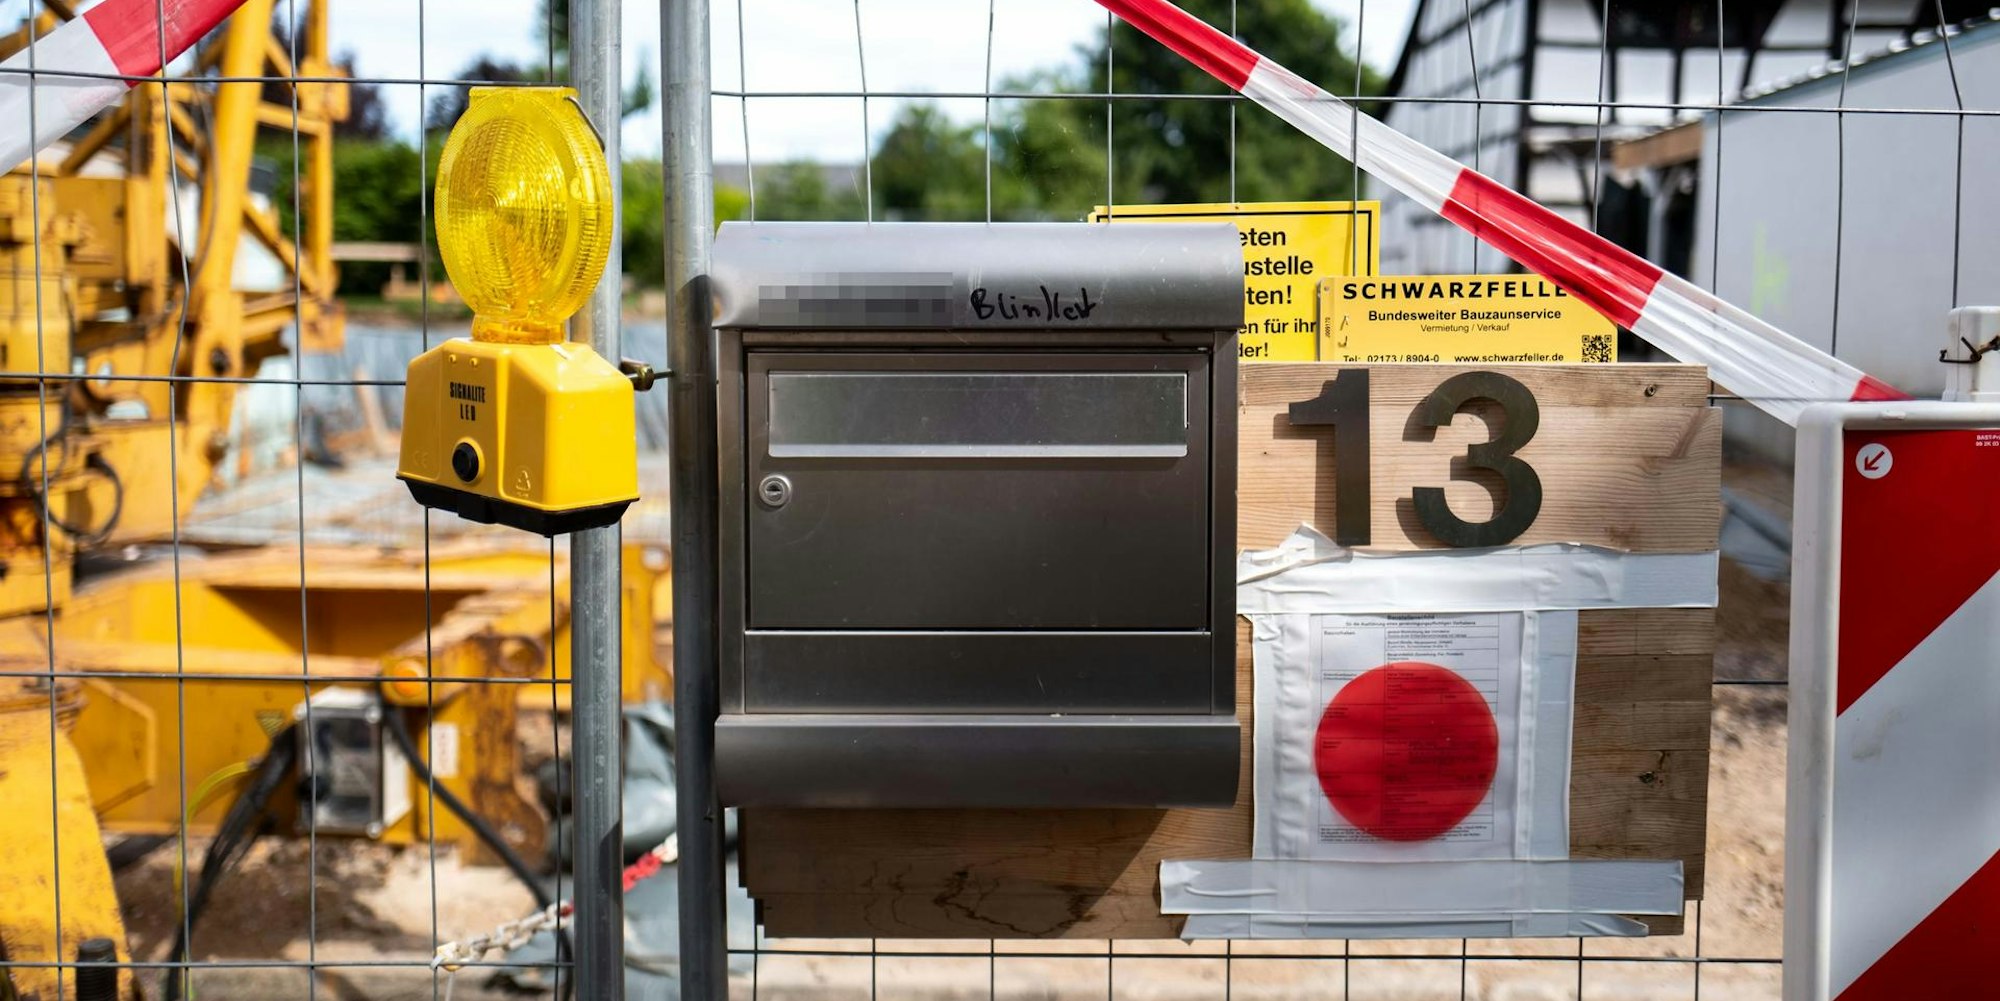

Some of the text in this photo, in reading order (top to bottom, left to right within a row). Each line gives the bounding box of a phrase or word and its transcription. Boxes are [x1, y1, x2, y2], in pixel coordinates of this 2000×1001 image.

[1343, 281, 1568, 299] SCHWARZFELLE
[1368, 308, 1561, 321] Bundesweiter Bauzaunservice
[1264, 318, 1289, 333] für
[1421, 323, 1469, 333] Vermietung
[1477, 323, 1510, 332] Verkauf
[1367, 354, 1397, 362] 02173
[1406, 354, 1440, 362] 8904-0
[1454, 352, 1564, 362] www.schwarzfeller.de
[450, 381, 485, 403] SIGNALITE
[460, 403, 476, 421] LED
[1289, 368, 1542, 548] 13
